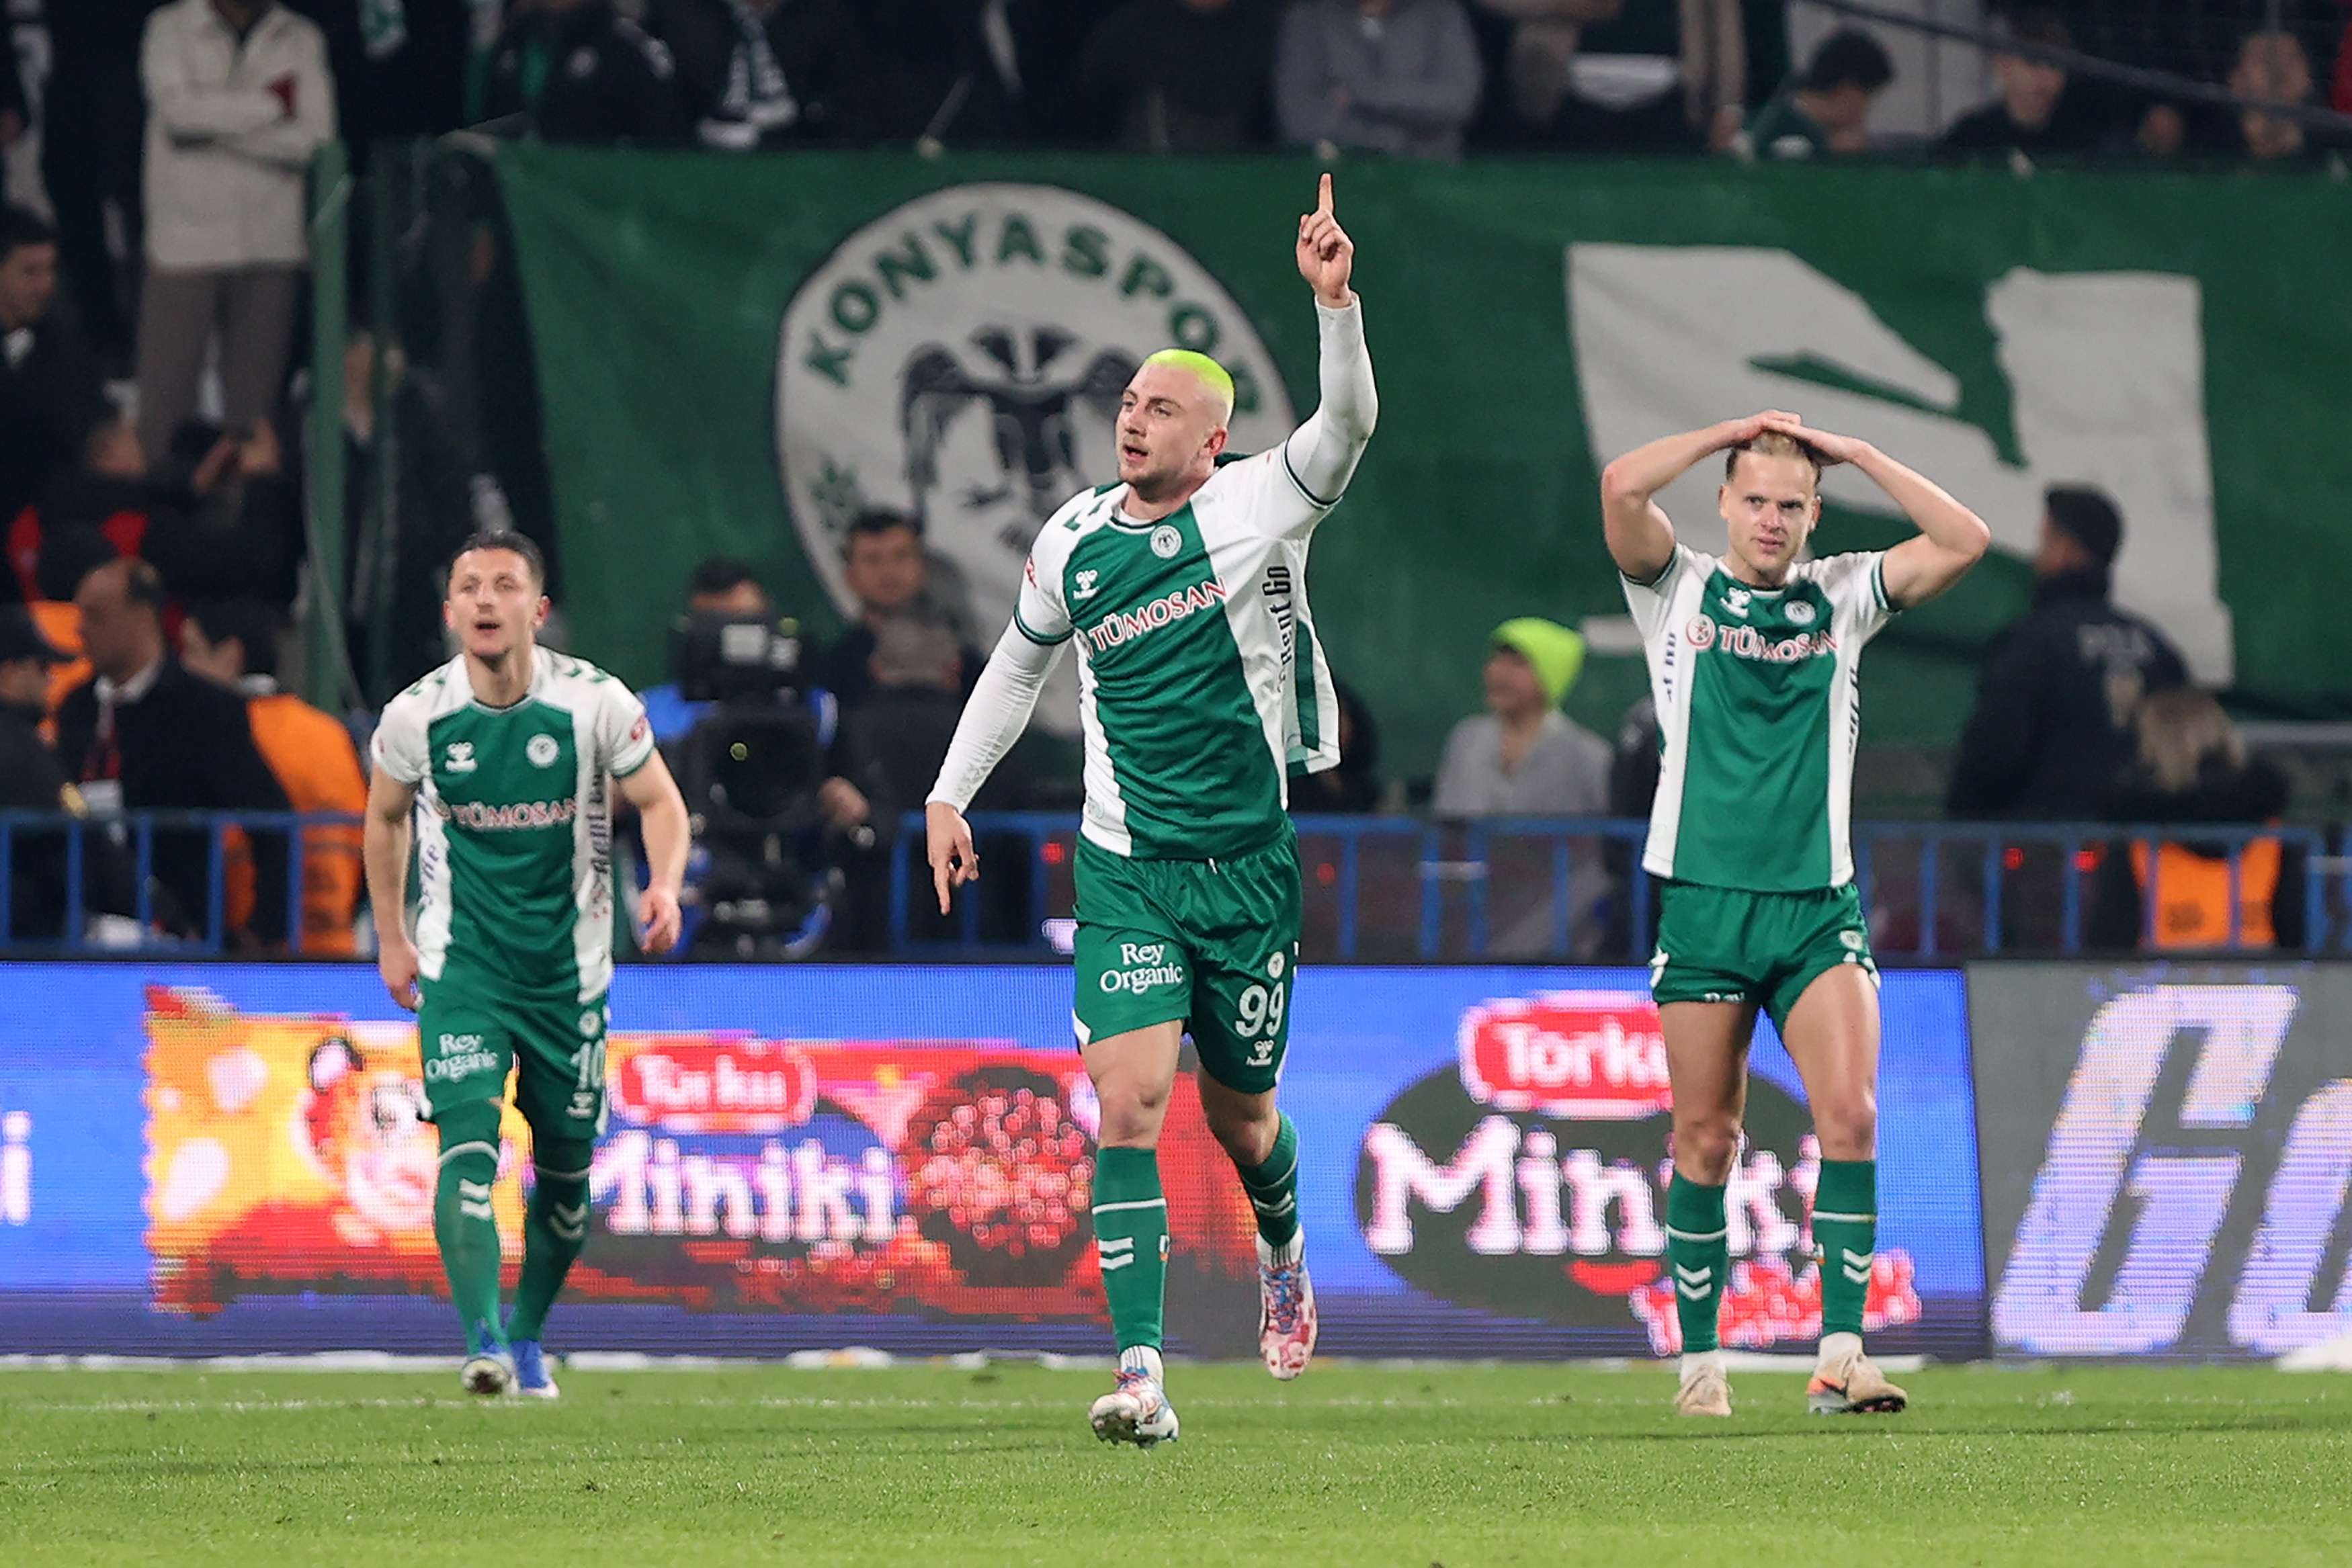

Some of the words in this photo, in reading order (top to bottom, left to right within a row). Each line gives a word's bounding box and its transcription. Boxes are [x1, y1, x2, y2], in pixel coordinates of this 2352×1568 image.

[1087, 576, 1228, 651] TÜMOSAN
[1718, 623, 1839, 664] TÜMOSAN
[1099, 961, 1183, 994] Organic
[1120, 943, 1165, 966] Rey
[1235, 982, 1284, 1037] 99
[1361, 1115, 1822, 1255] Minki
